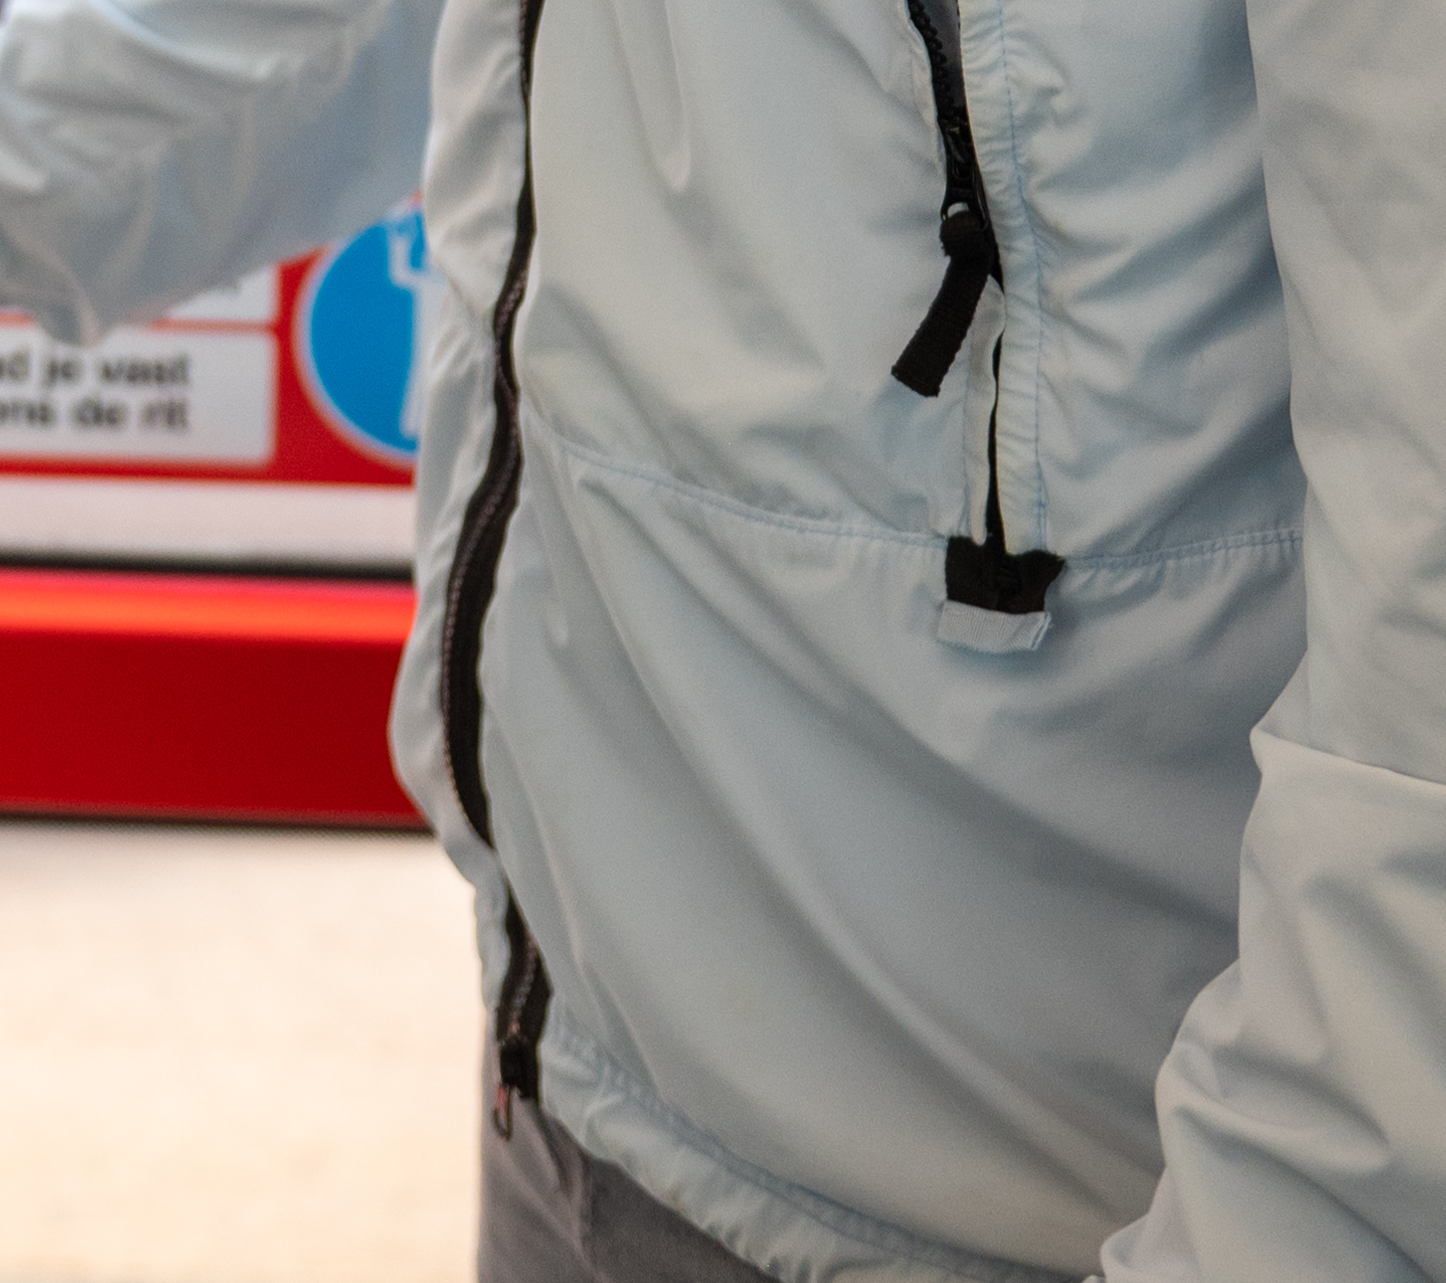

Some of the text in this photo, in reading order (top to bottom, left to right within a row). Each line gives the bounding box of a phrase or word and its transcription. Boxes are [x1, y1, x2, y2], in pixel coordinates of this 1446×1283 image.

[43, 350, 82, 386] je
[101, 354, 189, 385] vast
[74, 397, 126, 429] de
[144, 397, 189, 430] rit
